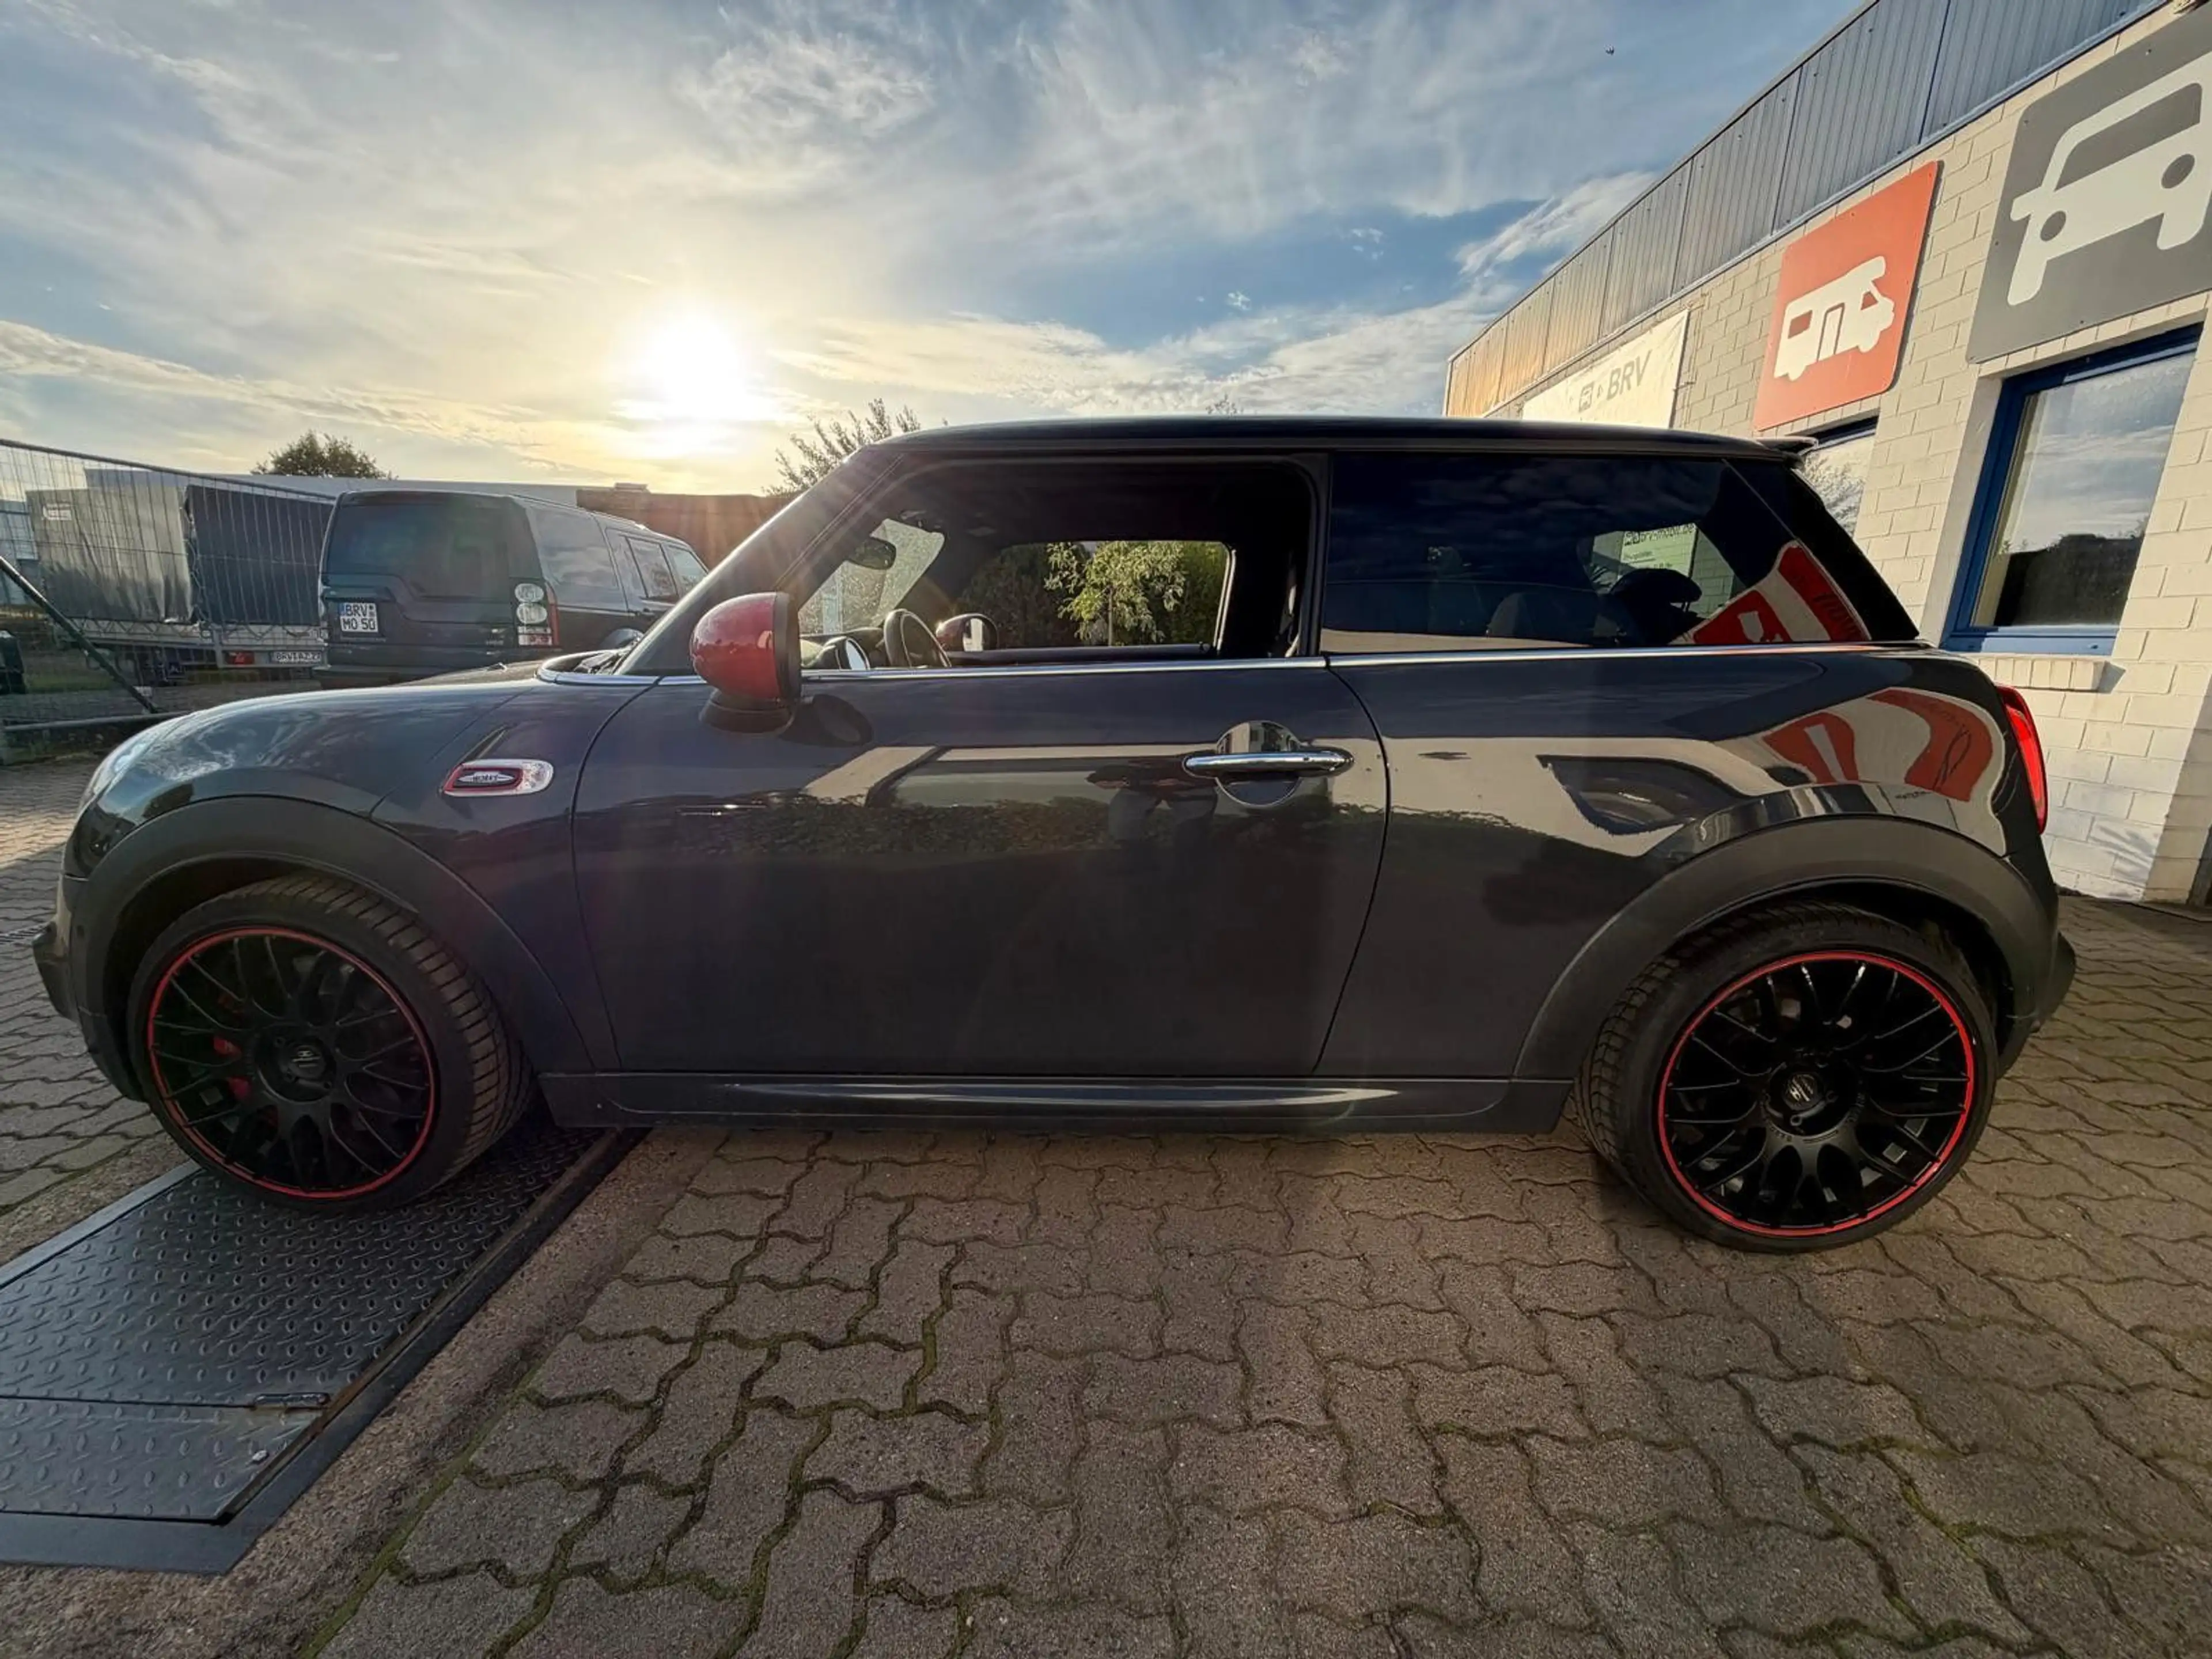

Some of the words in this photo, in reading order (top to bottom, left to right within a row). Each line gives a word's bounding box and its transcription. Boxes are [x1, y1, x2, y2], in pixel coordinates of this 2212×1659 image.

[1607, 349, 1653, 400] BRV
[346, 604, 367, 616] BRV
[343, 618, 357, 630] MO
[361, 618, 376, 630] 50
